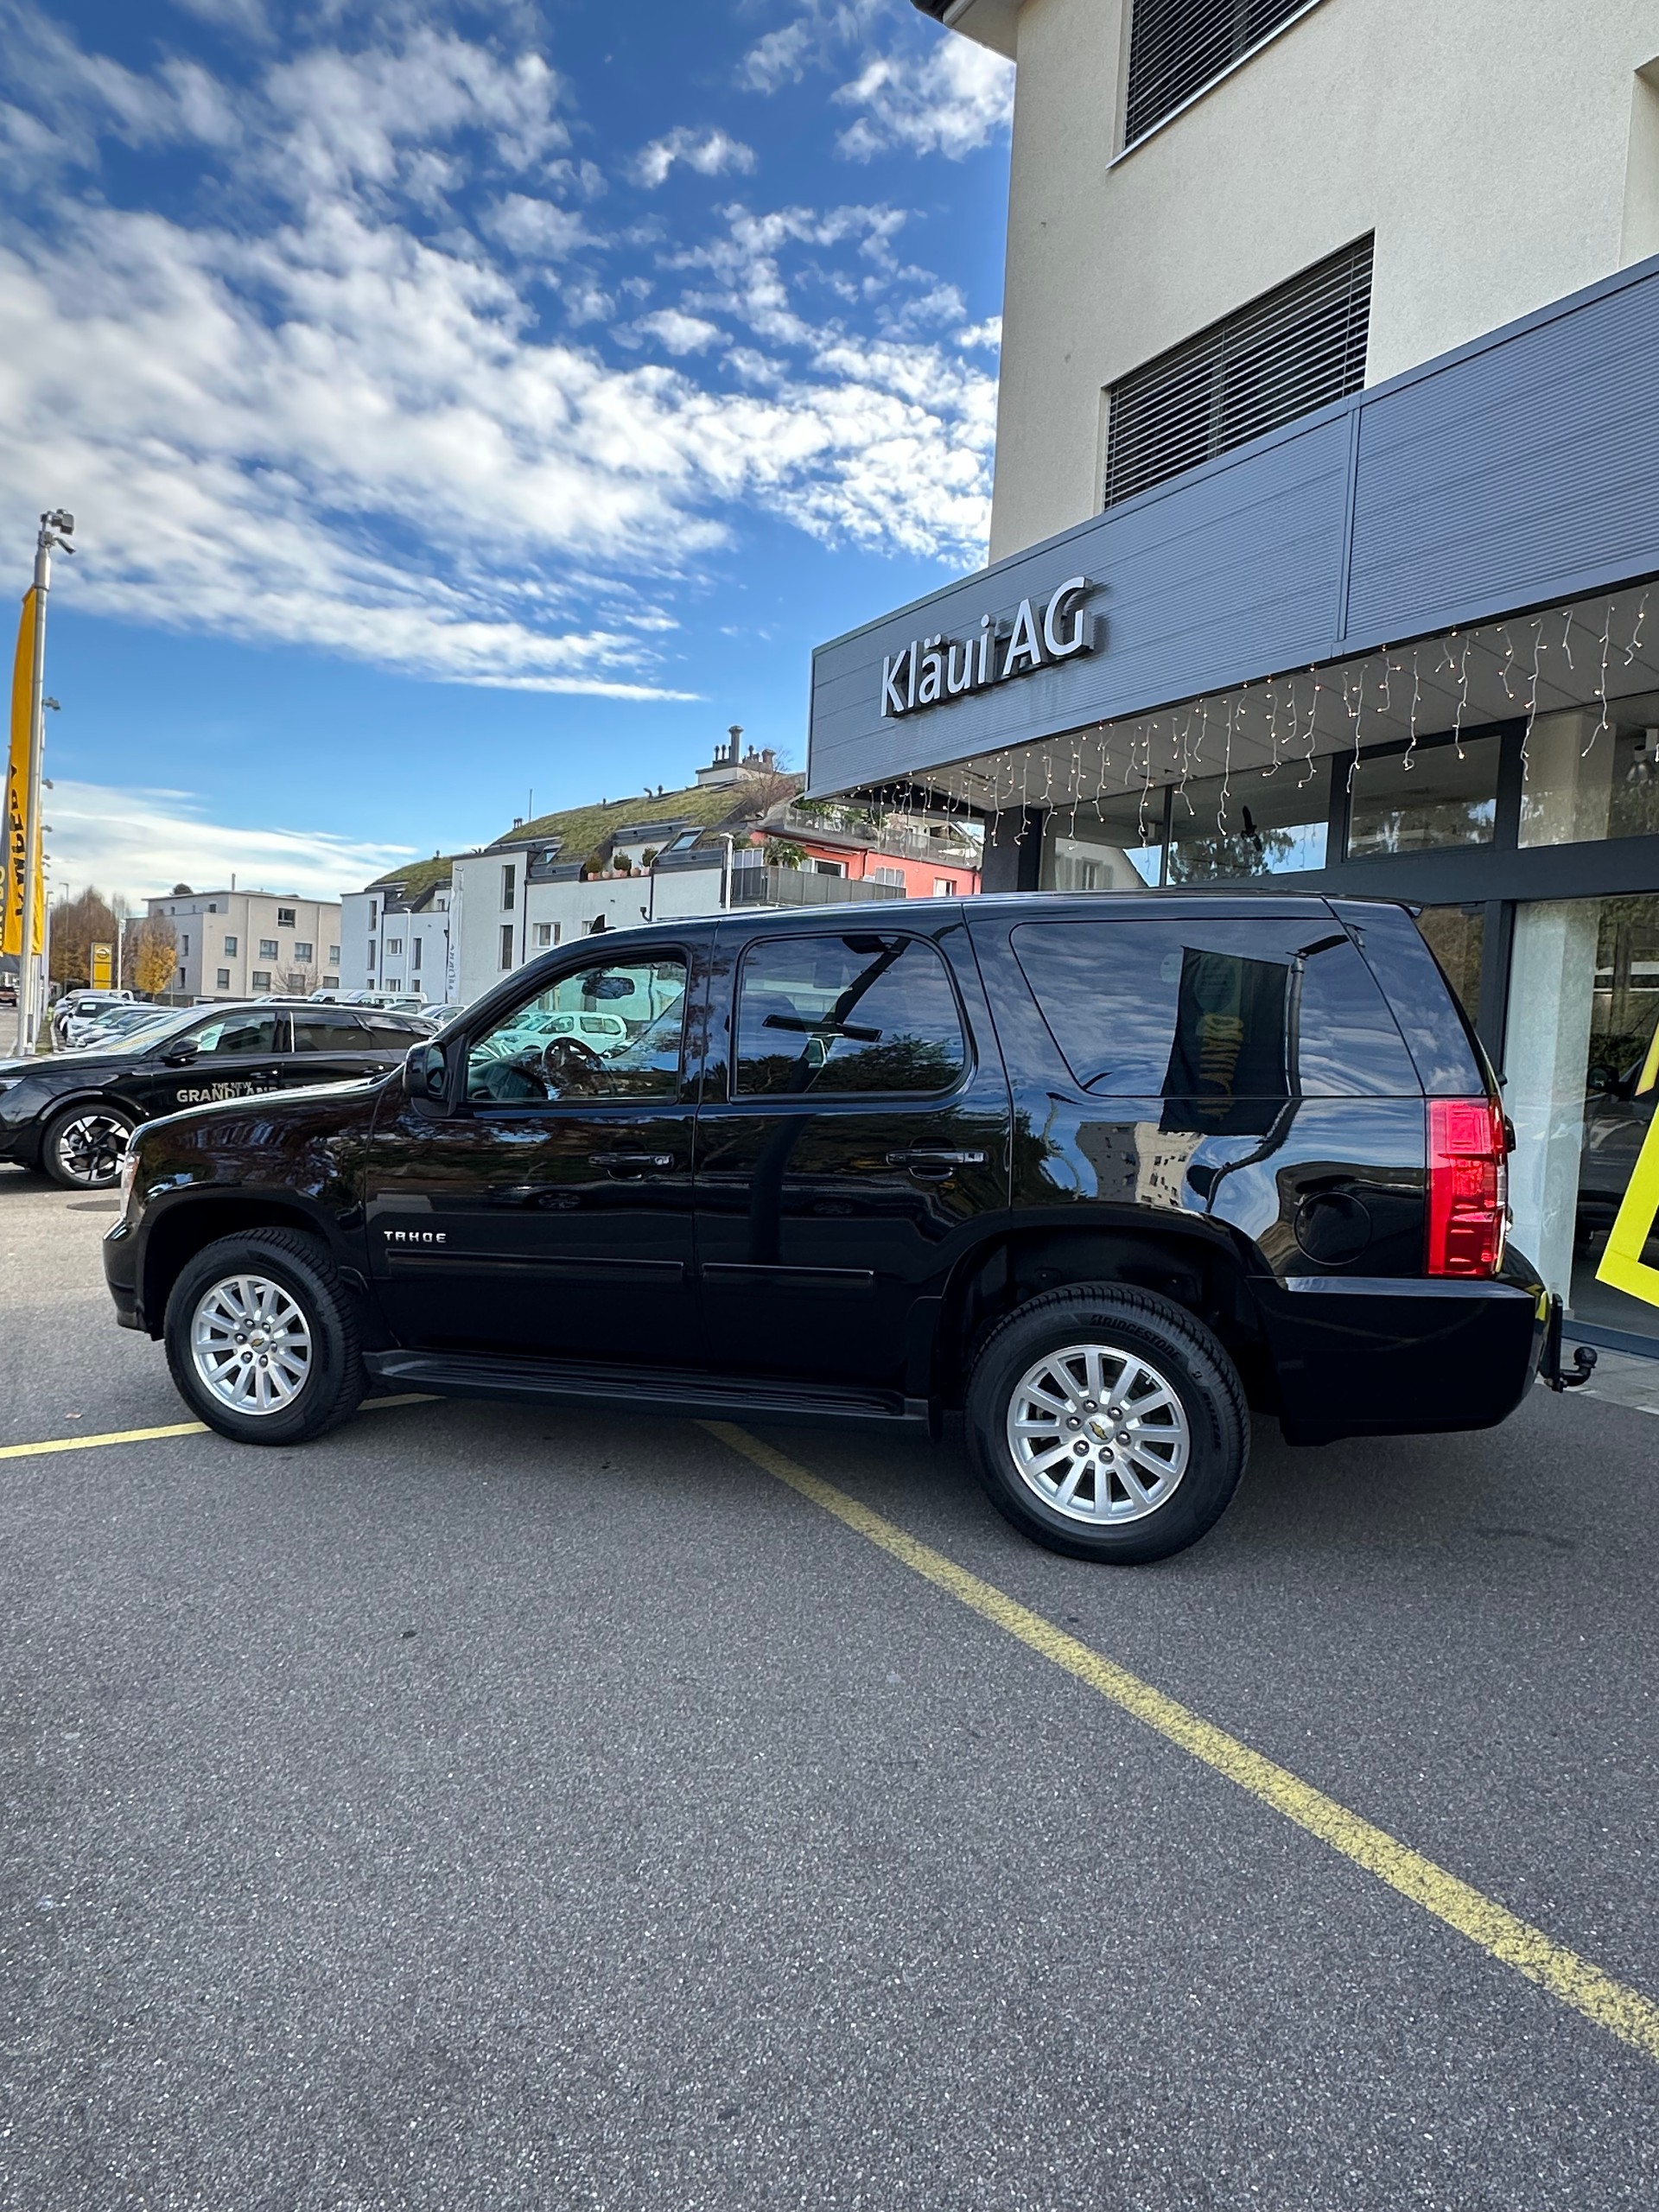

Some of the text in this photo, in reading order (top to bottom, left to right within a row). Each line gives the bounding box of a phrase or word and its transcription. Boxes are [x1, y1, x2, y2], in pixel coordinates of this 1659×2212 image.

[880, 576, 1091, 718] Kläui AG
[384, 1230, 447, 1243] TAHOE
[1091, 1314, 1180, 1358] BRIDGESTONE
